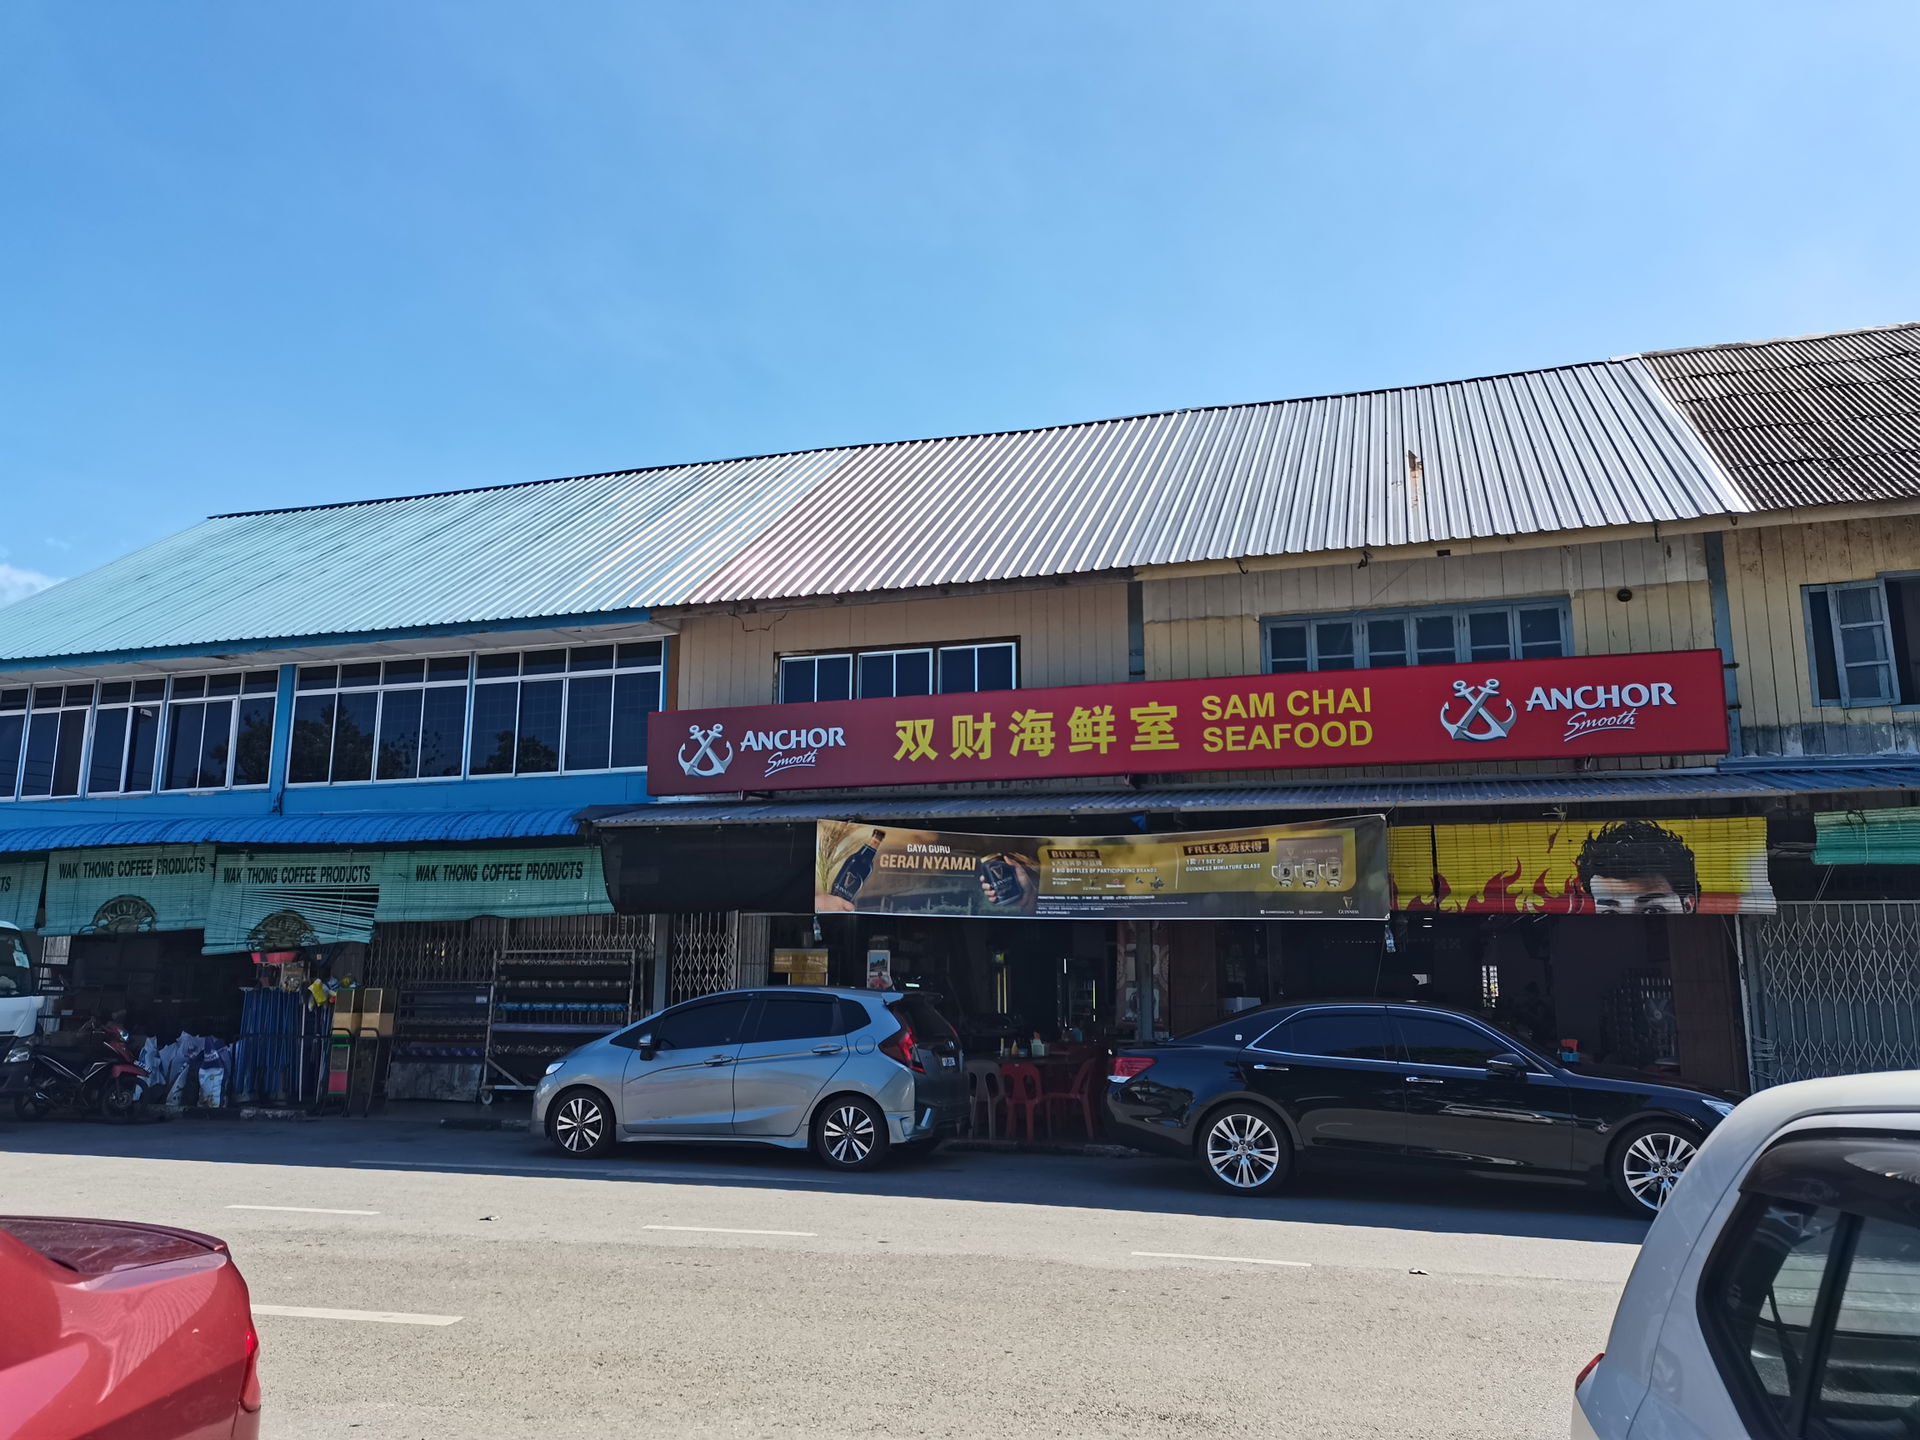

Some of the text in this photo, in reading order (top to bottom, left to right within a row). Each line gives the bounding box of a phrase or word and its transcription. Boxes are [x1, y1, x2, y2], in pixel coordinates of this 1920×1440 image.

[1202, 687, 1371, 721] SAM CHAI
[1525, 682, 1677, 712] ANCHOR
[893, 701, 1180, 762] 双财海鲜室
[1564, 708, 1638, 736] Smooth
[740, 727, 846, 752] ANCHOR
[1202, 720, 1373, 752] SEAFOOD
[765, 749, 818, 773] Smooth
[907, 843, 951, 854] GAYA GURU
[1187, 845, 1216, 854] FREE
[59, 856, 206, 879] WAK THONG COFFEE PRODUCTS
[224, 865, 371, 884] WAK THONG COFFEE PRODUCTS
[416, 861, 584, 881] WAK THONG COFFEE PRODUCTS
[879, 854, 977, 871] GERAI NYAMAI
